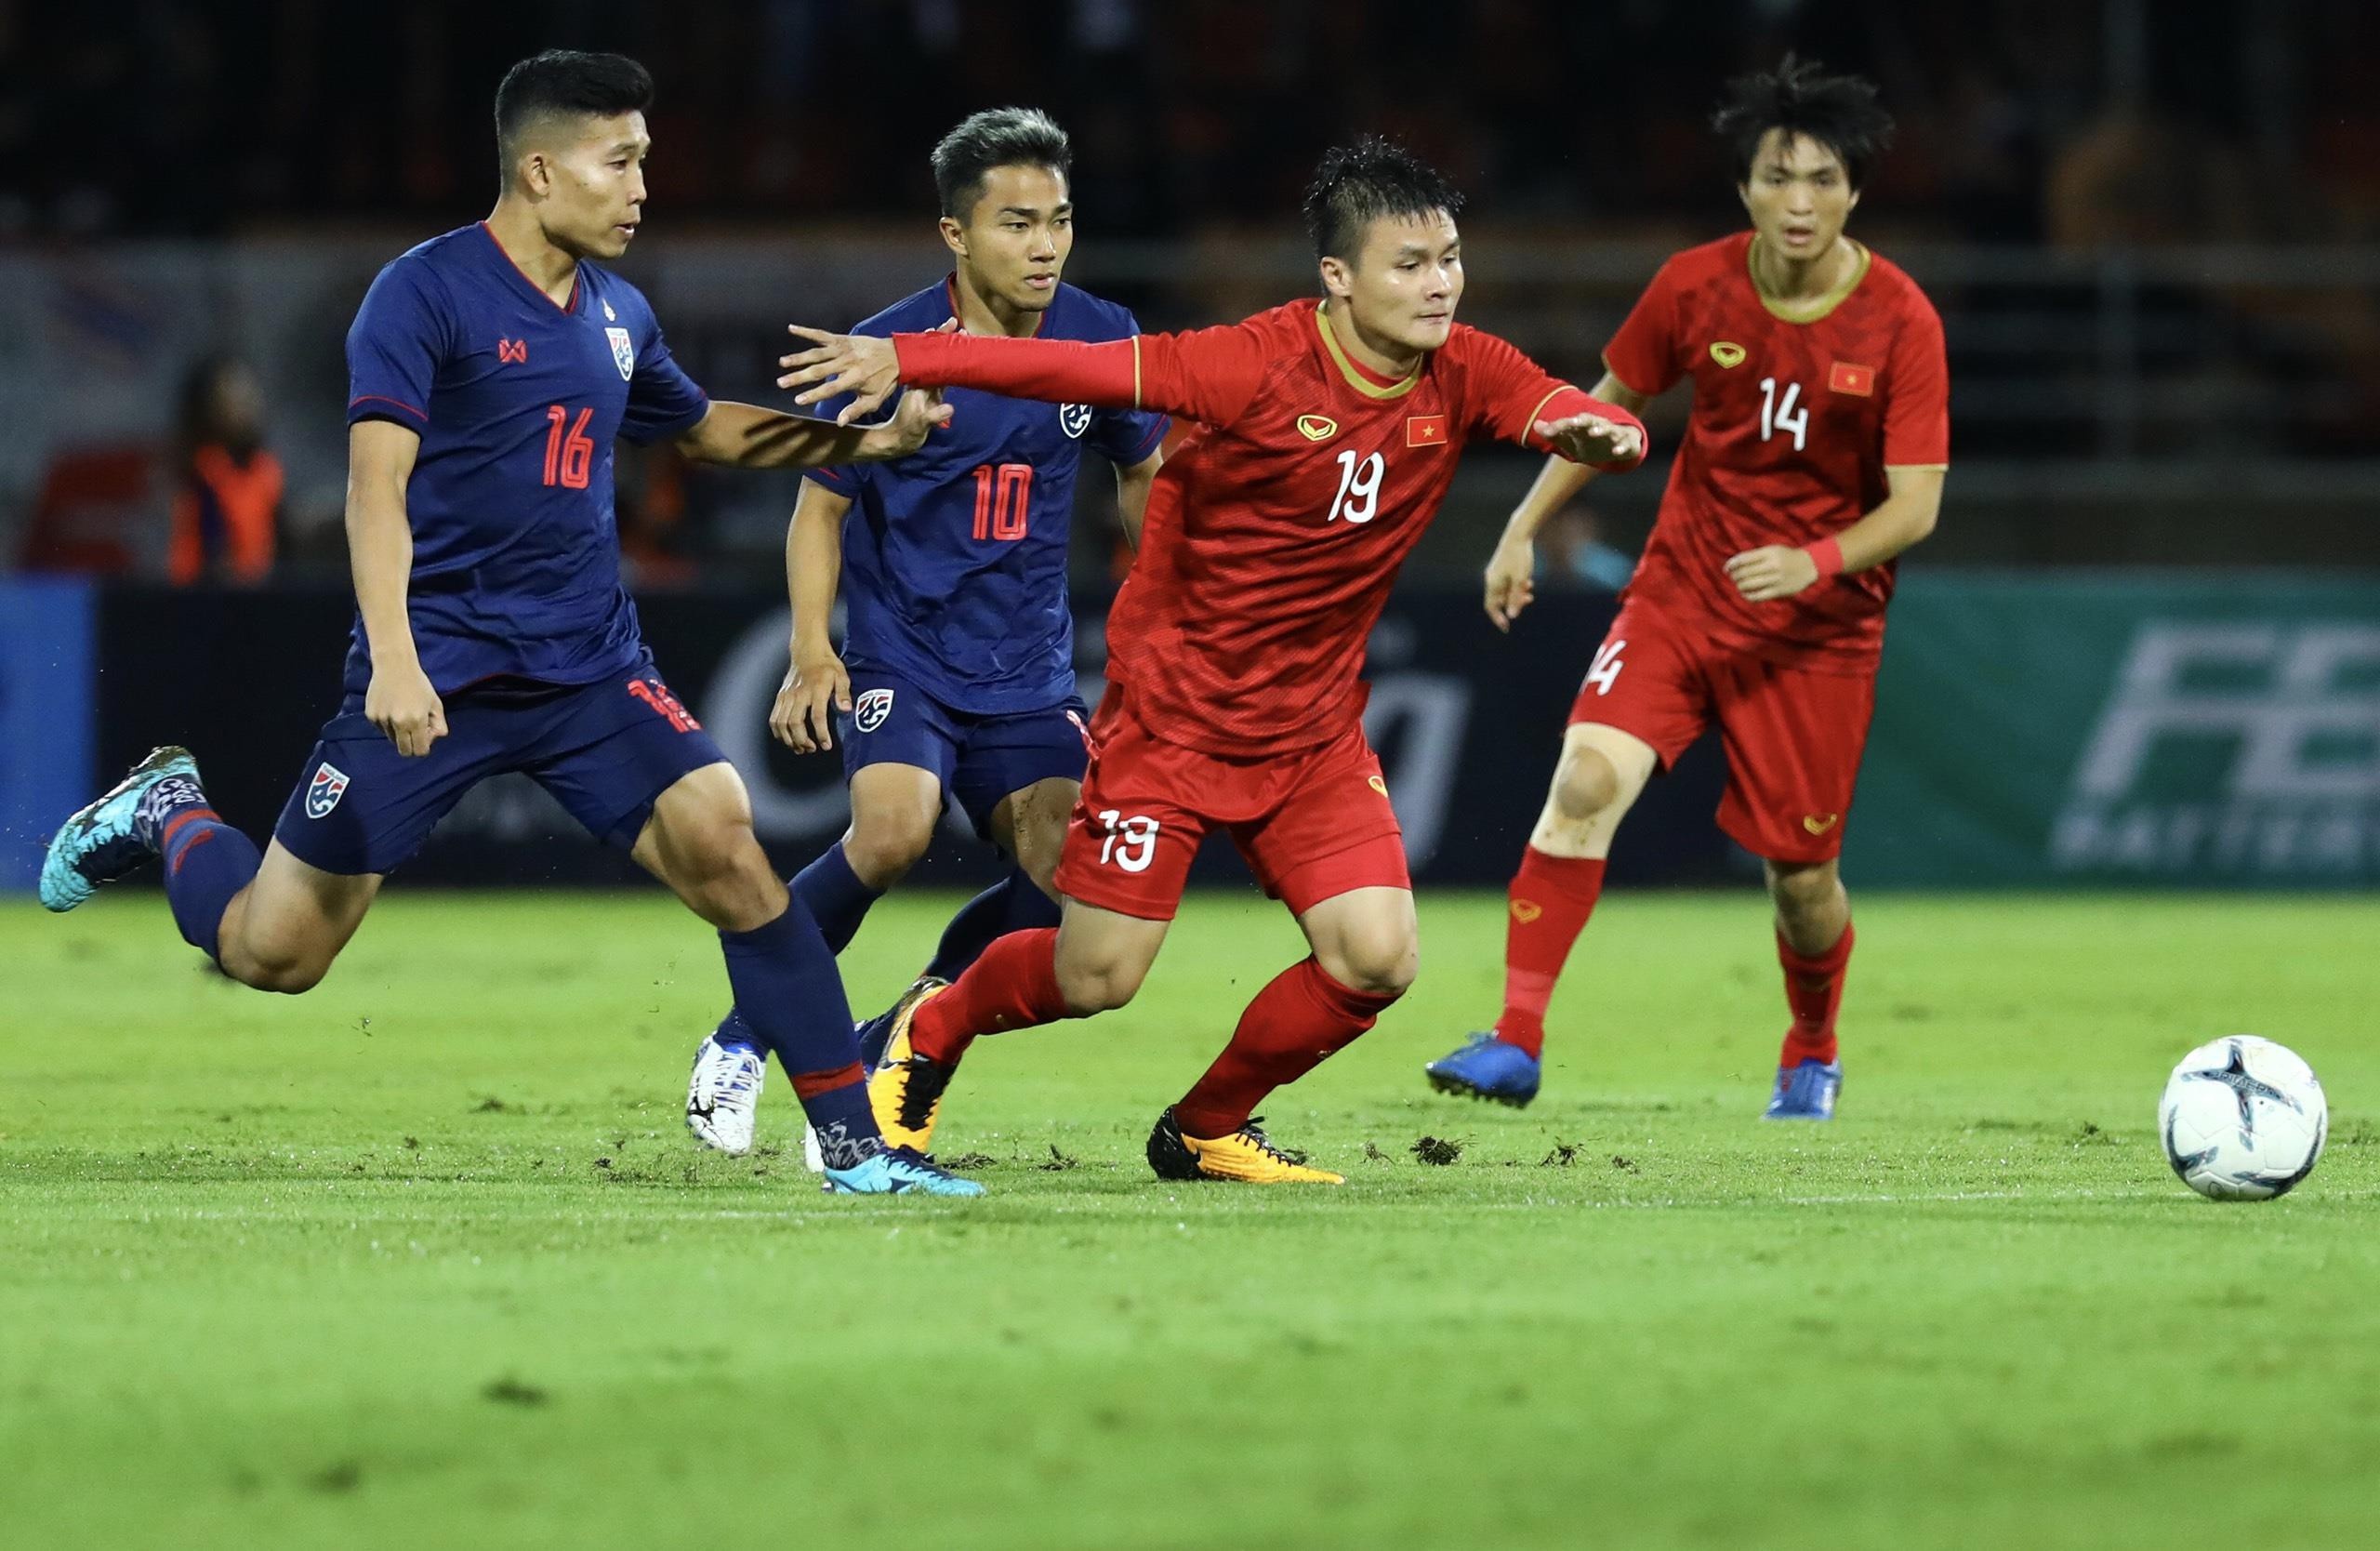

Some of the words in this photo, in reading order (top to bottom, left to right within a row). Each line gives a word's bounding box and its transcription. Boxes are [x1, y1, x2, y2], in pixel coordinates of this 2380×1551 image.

[543, 404, 595, 490] 16
[1760, 378, 1808, 451] 14
[971, 463, 1035, 541] 10
[1328, 449, 1385, 524] 19
[1098, 809, 1159, 872] 19
[2053, 807, 2380, 865] BATTER
